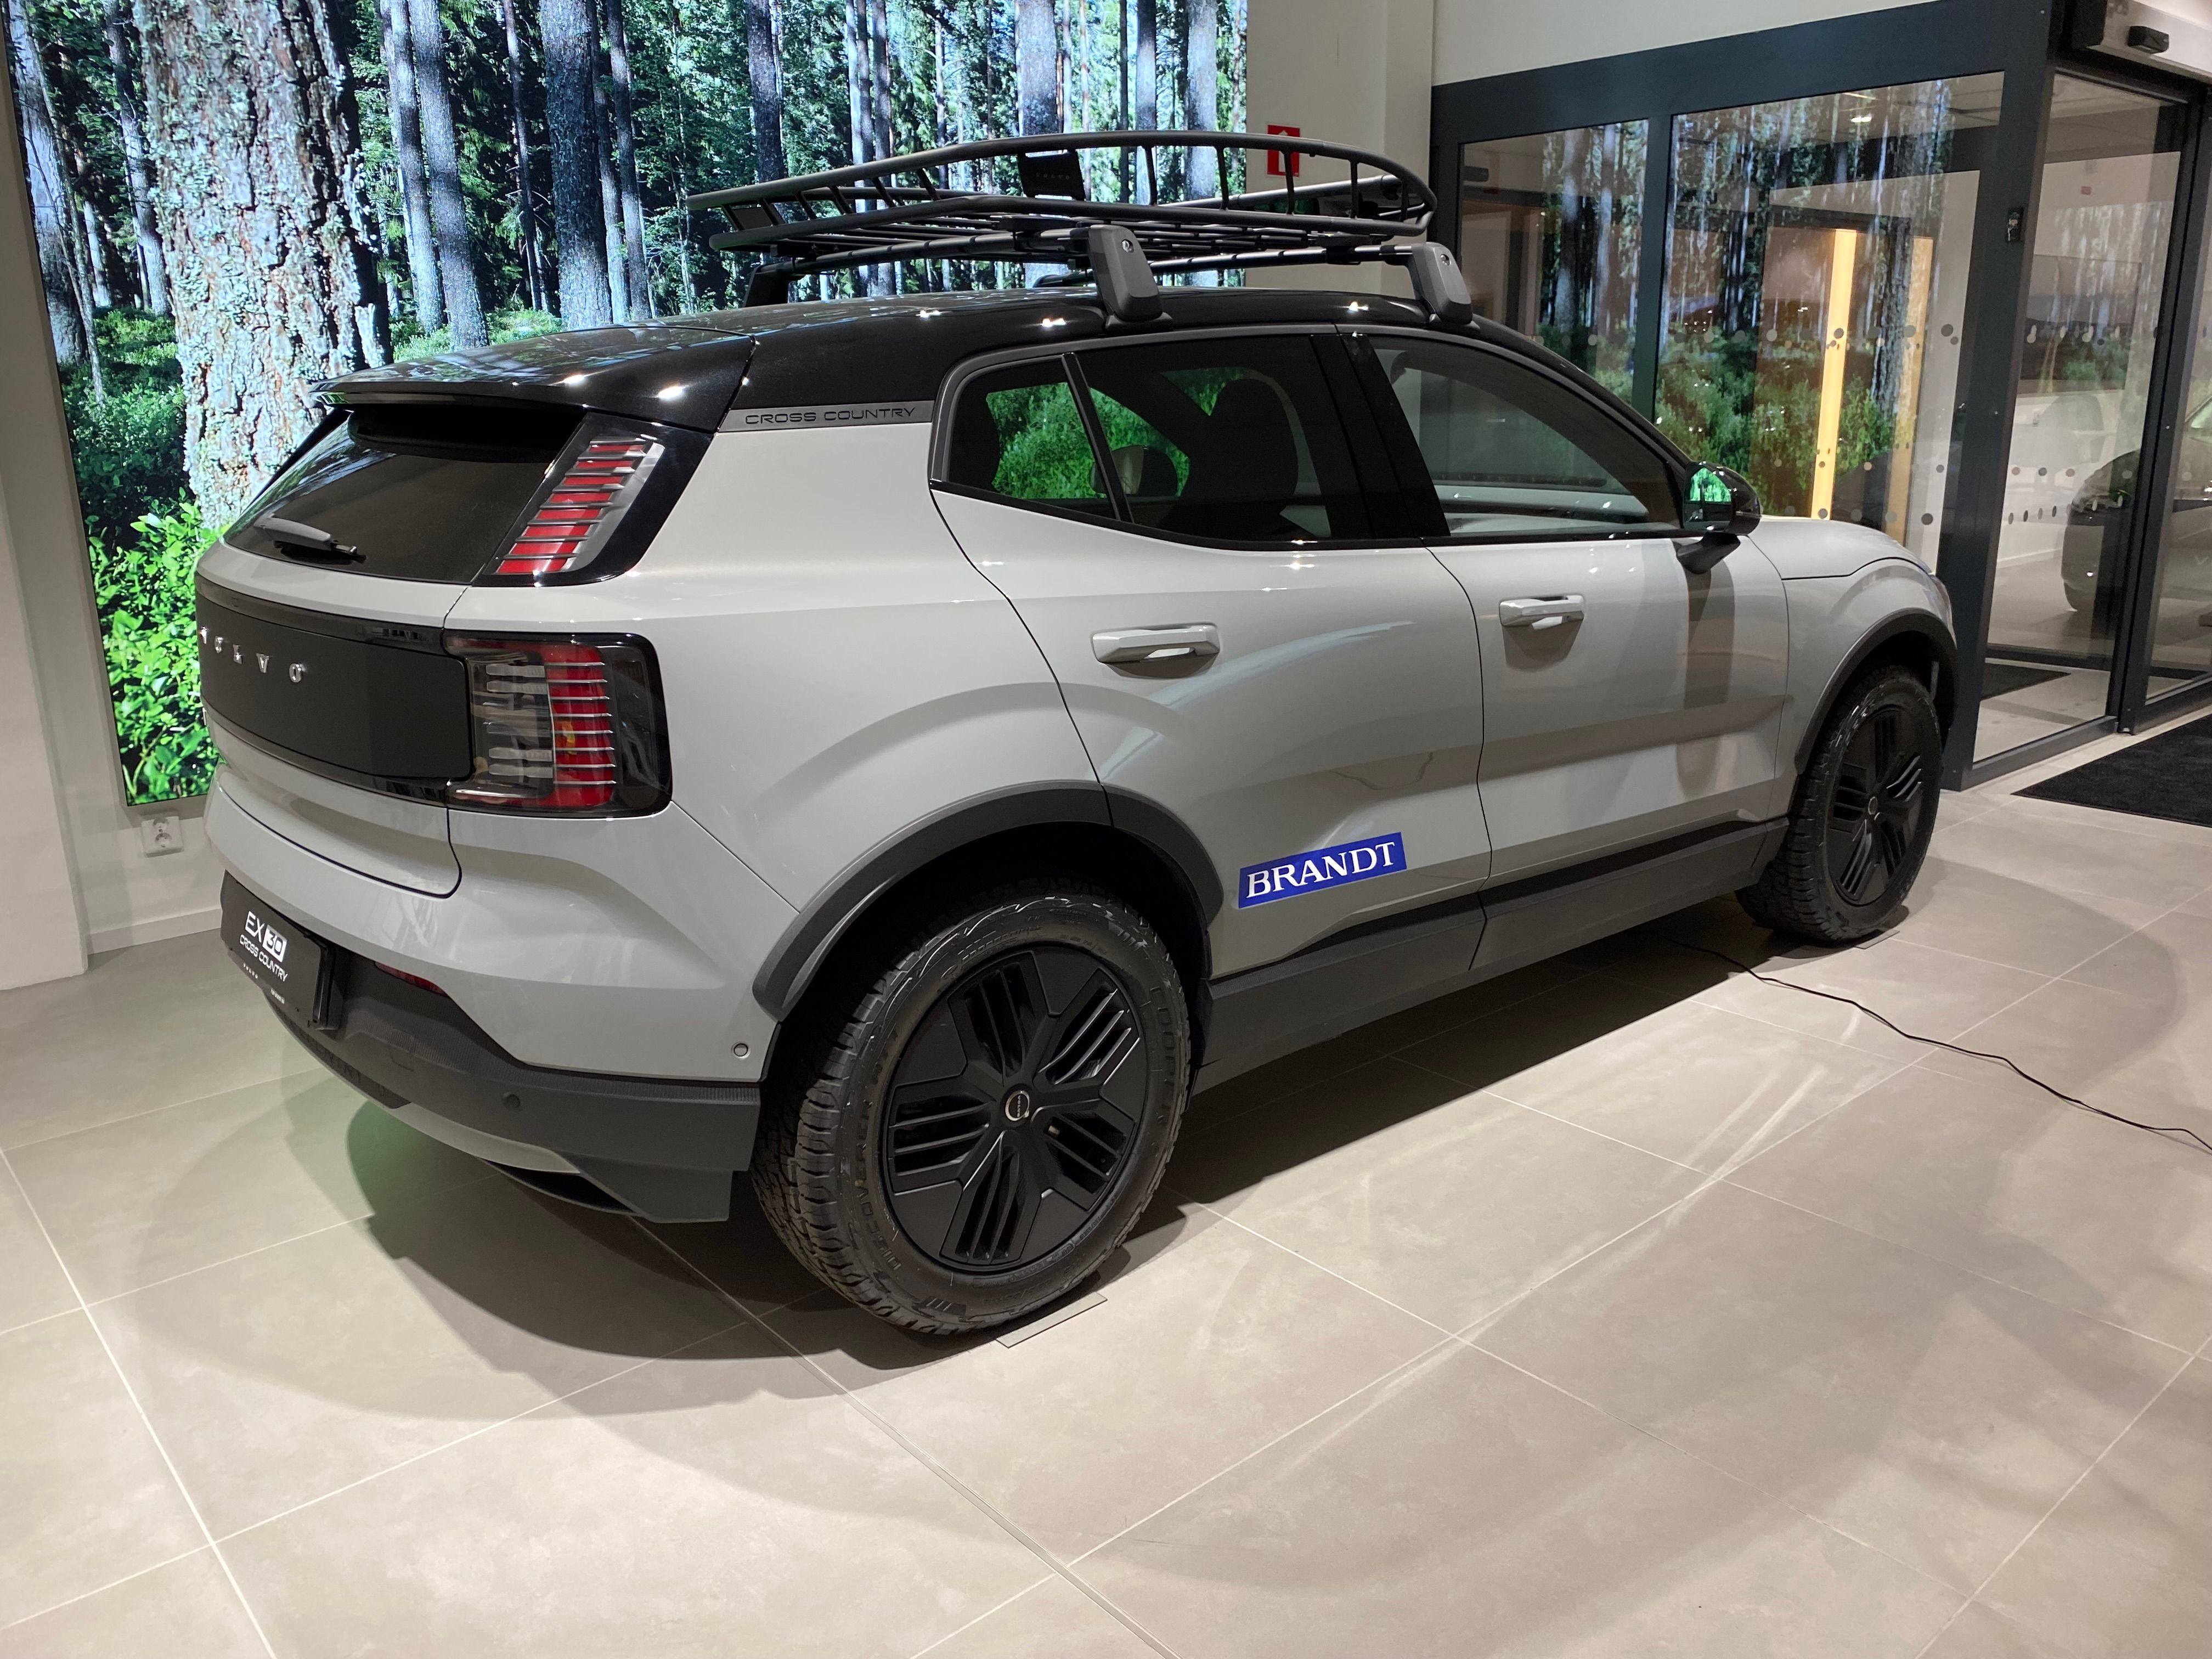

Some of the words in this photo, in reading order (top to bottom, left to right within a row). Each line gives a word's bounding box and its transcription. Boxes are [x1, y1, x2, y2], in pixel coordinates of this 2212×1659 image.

[745, 412, 816, 425] CROSS
[823, 407, 916, 421] COUNTRY
[200, 626, 302, 683] VOLVO
[1246, 842, 1395, 899] BRANDT
[239, 934, 258, 957] CROSS
[258, 951, 289, 982] COUNTRY
